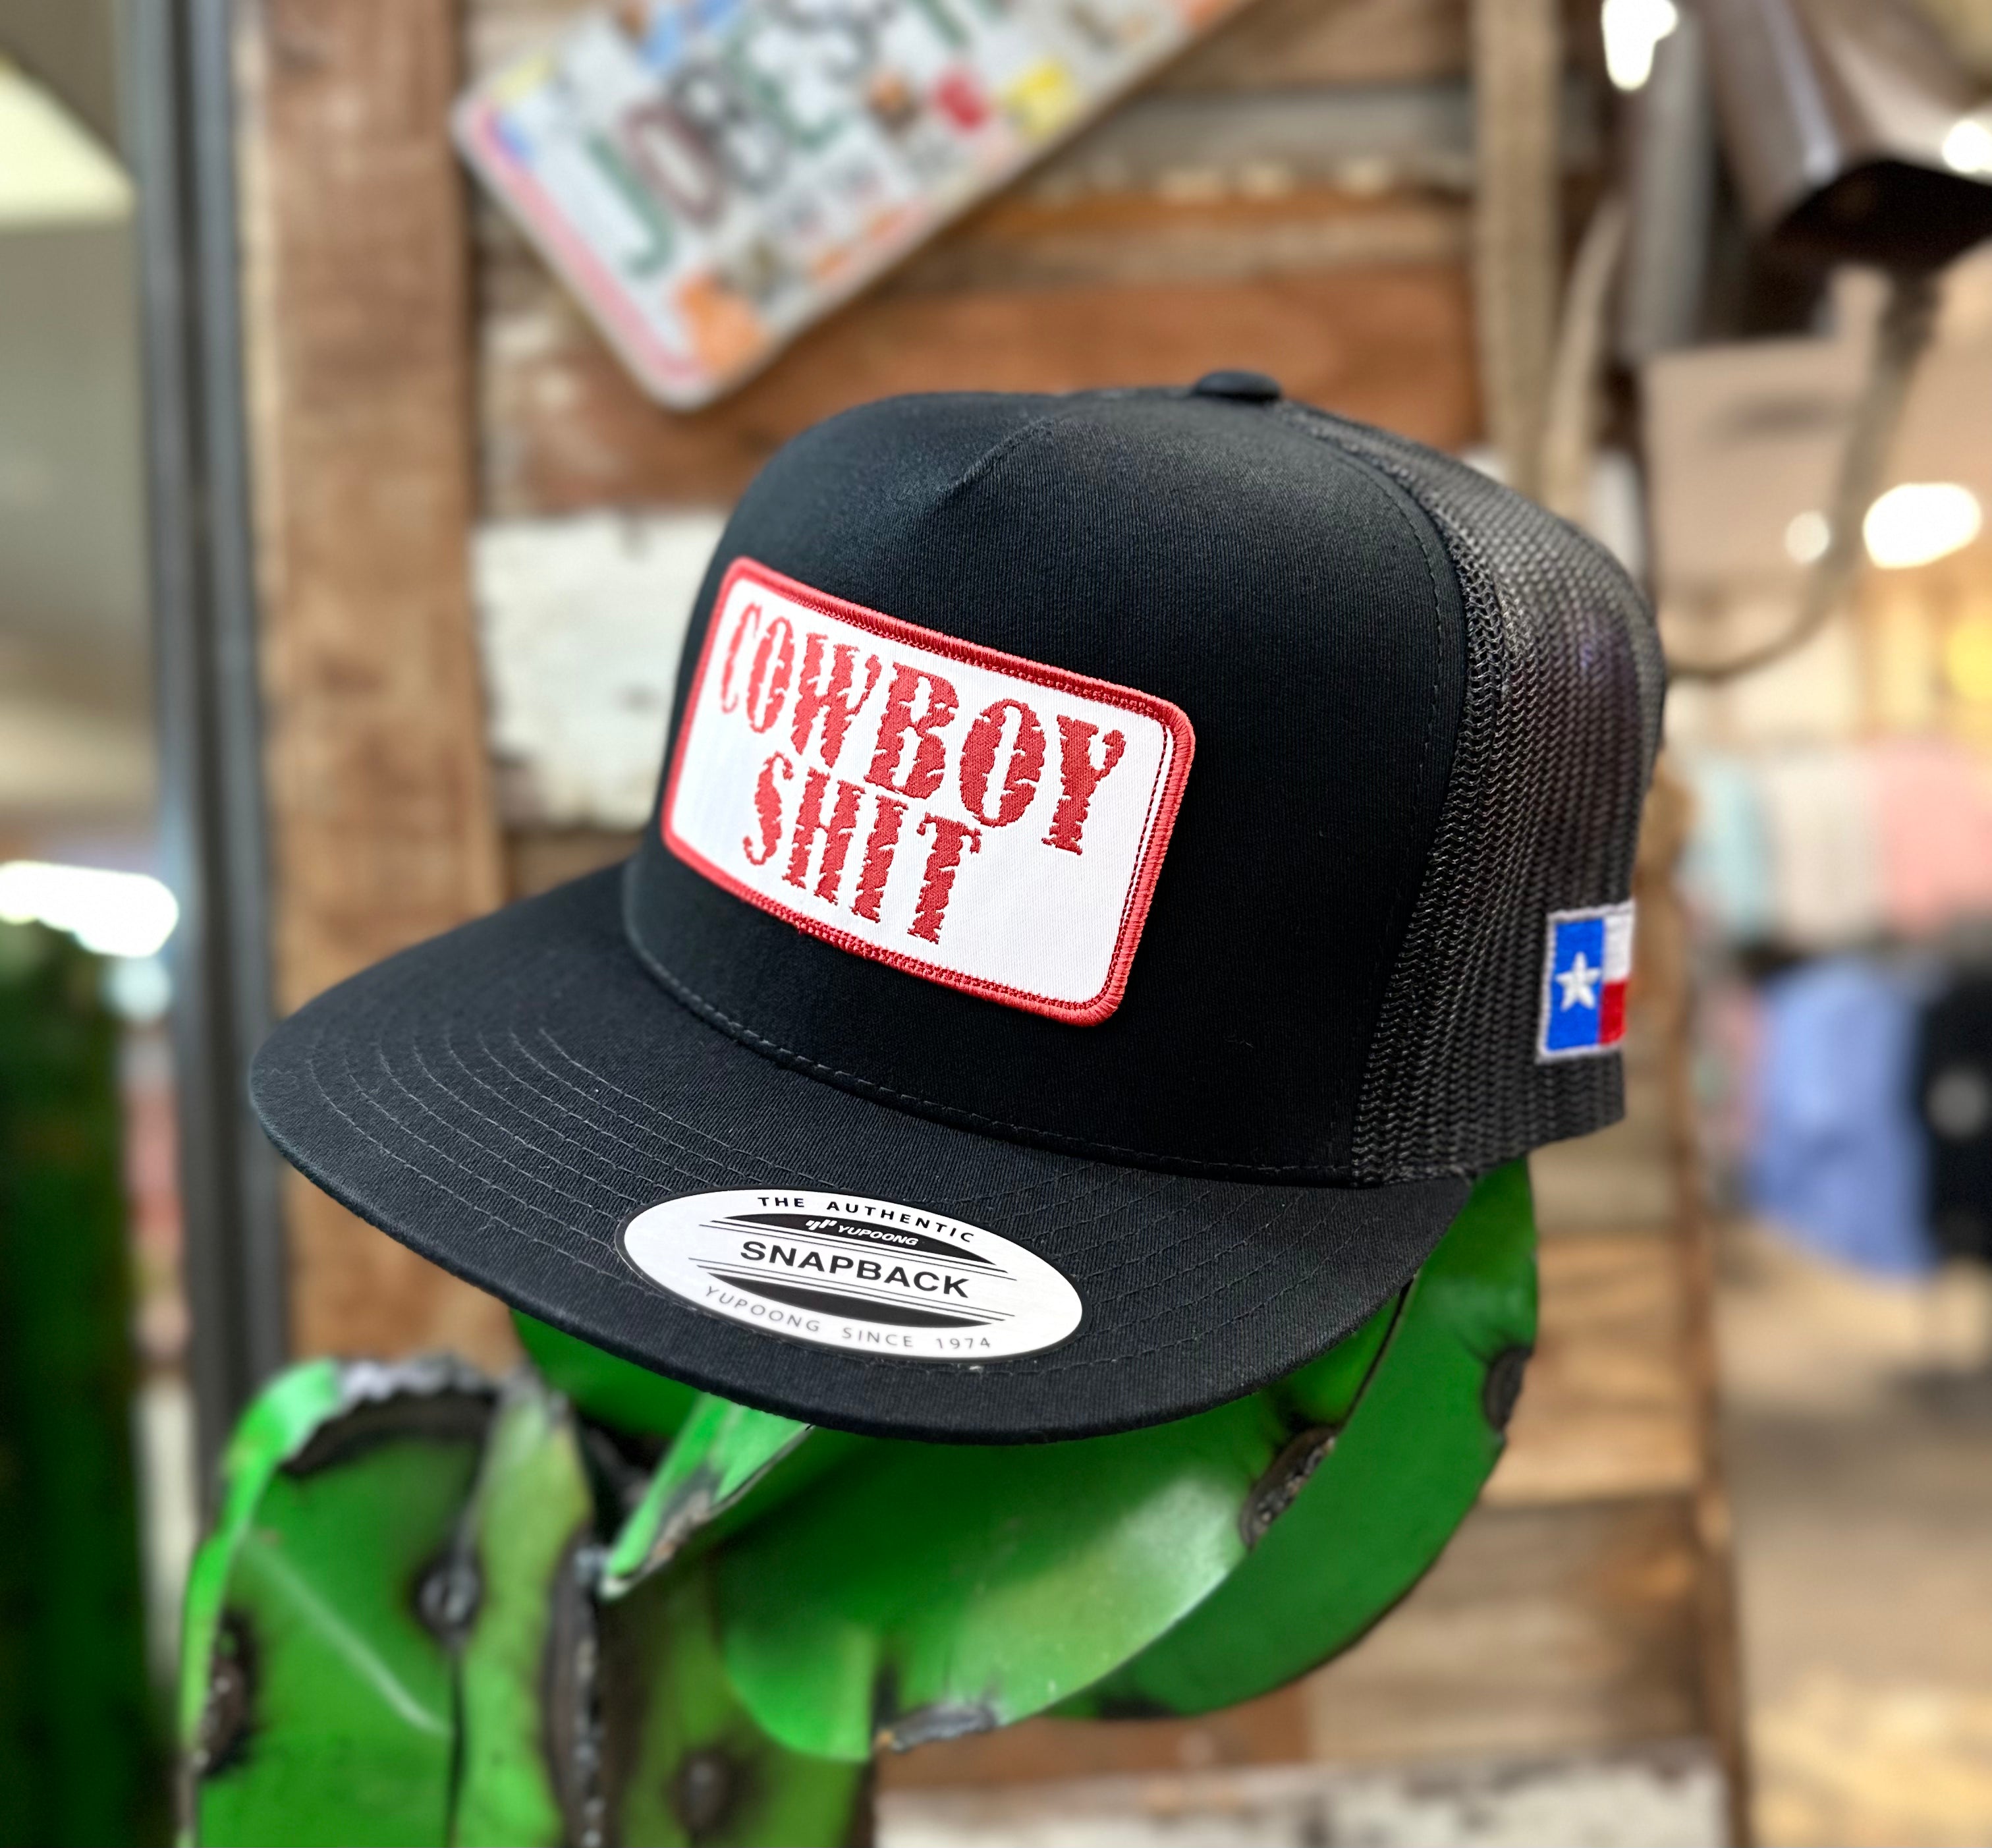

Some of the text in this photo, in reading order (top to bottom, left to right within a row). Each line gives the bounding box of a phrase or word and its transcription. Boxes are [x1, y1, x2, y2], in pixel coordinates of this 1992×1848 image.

[721, 602, 1126, 854] COWBOY
[743, 751, 981, 945] SHIT
[758, 1196, 975, 1243] THE AUTHENTIC
[838, 1225, 918, 1246] YUPOONG
[740, 1241, 969, 1298] SNAPBACK
[705, 1285, 991, 1349] YUPOONG SINCE 1974
